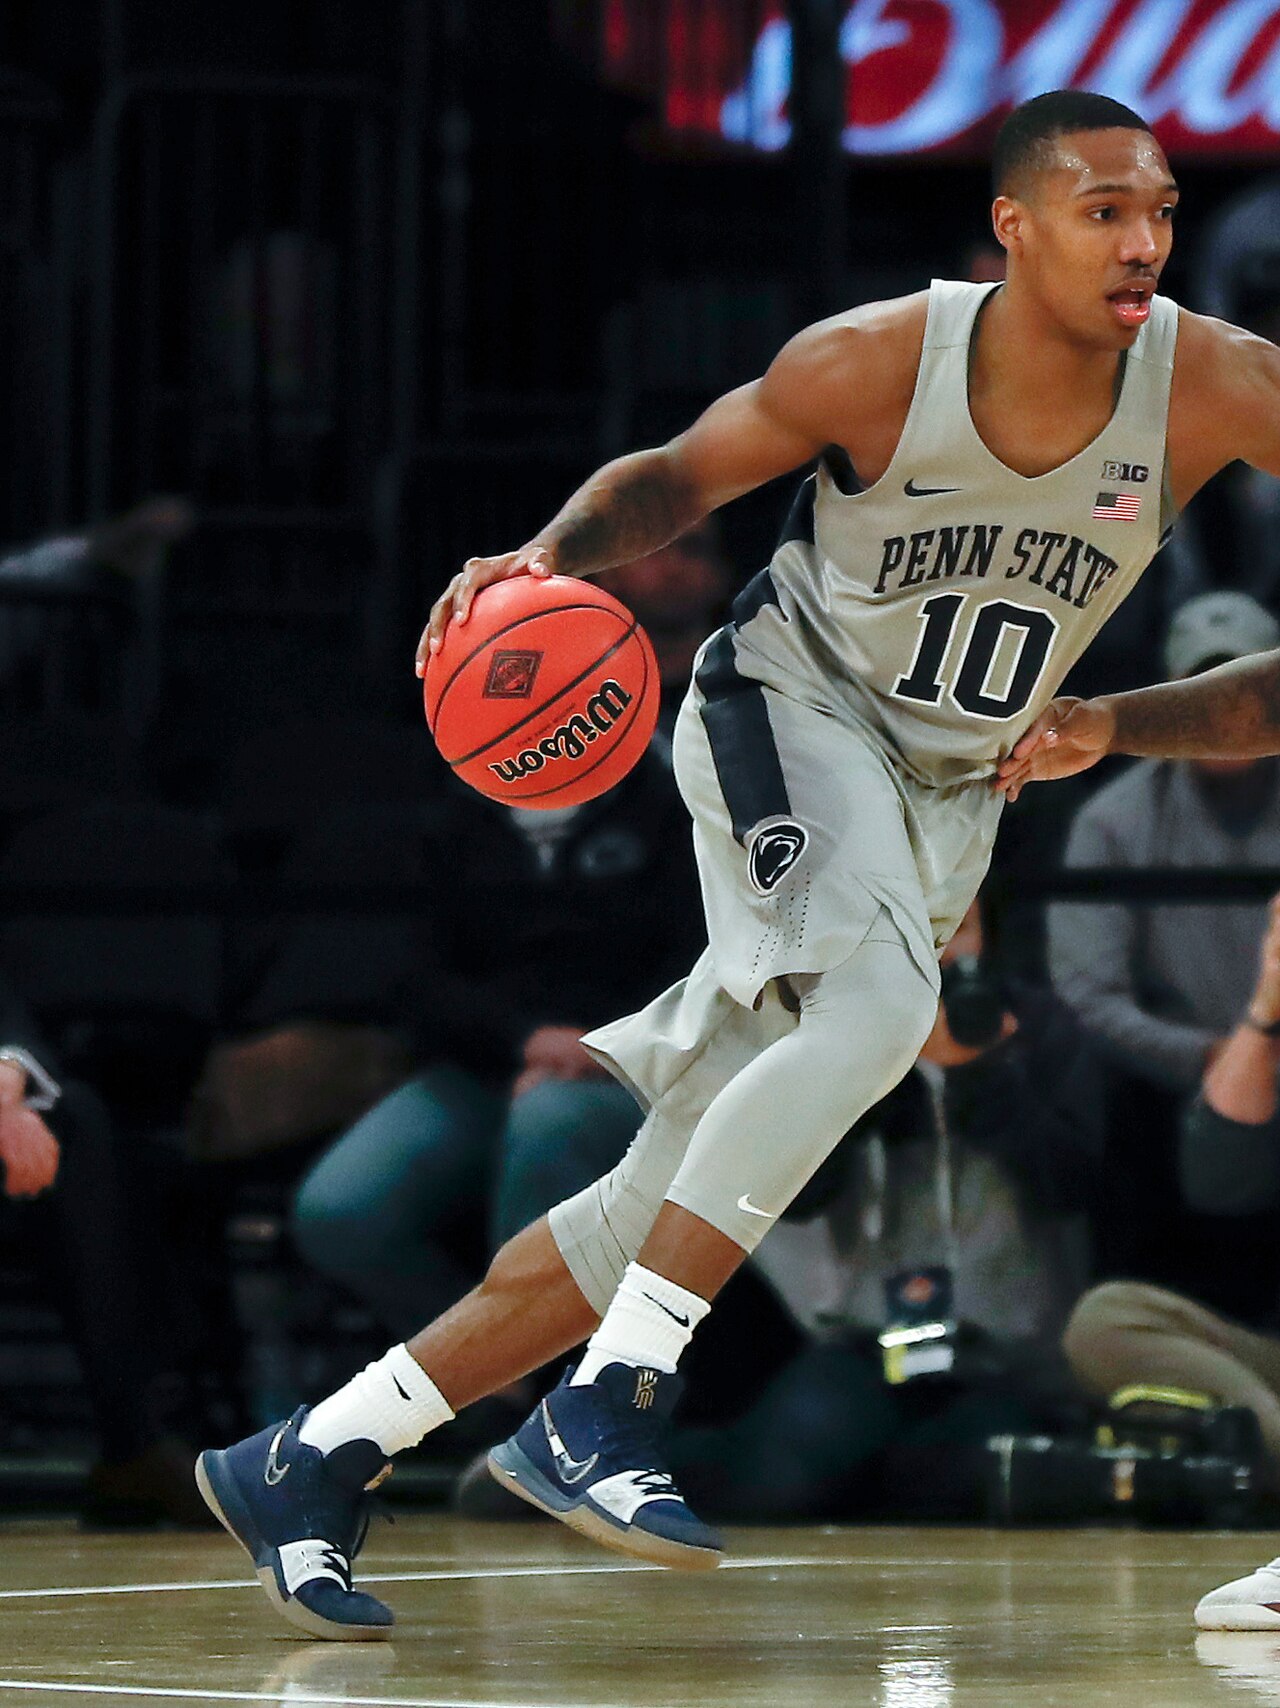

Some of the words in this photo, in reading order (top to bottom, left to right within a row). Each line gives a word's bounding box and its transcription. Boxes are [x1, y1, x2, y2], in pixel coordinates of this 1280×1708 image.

[1101, 460, 1150, 483] BIG
[873, 525, 1003, 593] PENN
[1005, 529, 1119, 609] STATE
[889, 591, 1061, 723] 10
[489, 678, 632, 783] Wilson
